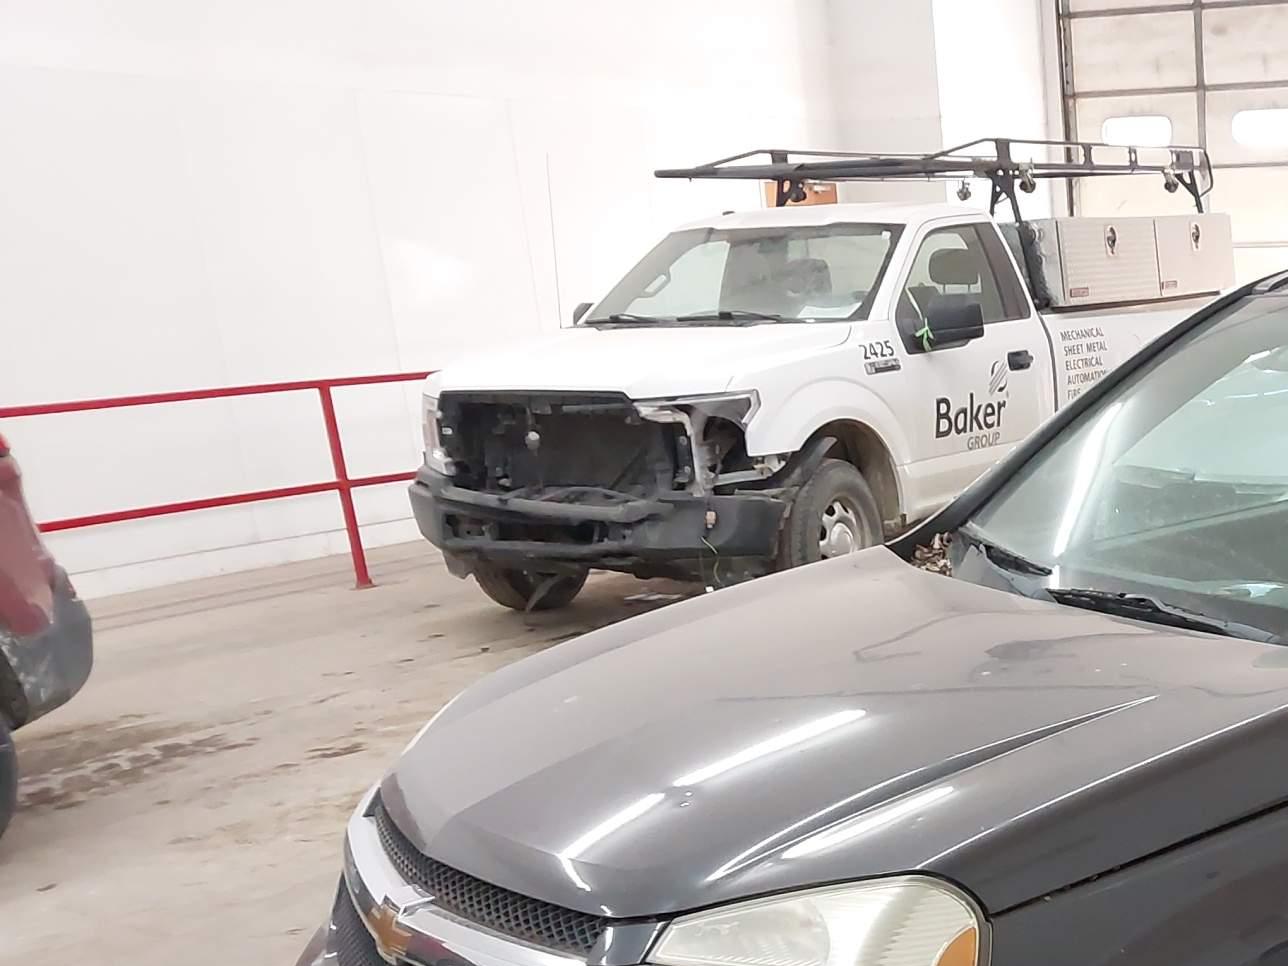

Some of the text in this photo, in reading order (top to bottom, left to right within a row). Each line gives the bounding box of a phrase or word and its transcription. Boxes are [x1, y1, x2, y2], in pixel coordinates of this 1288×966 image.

[1060, 327, 1104, 341] MECHANICAL
[858, 340, 894, 360] 2425
[1064, 341, 1107, 356] SHEET METAL
[1065, 356, 1103, 371] ELECTRICAL
[935, 392, 1006, 438] Baker
[967, 432, 1000, 450] GROUP
